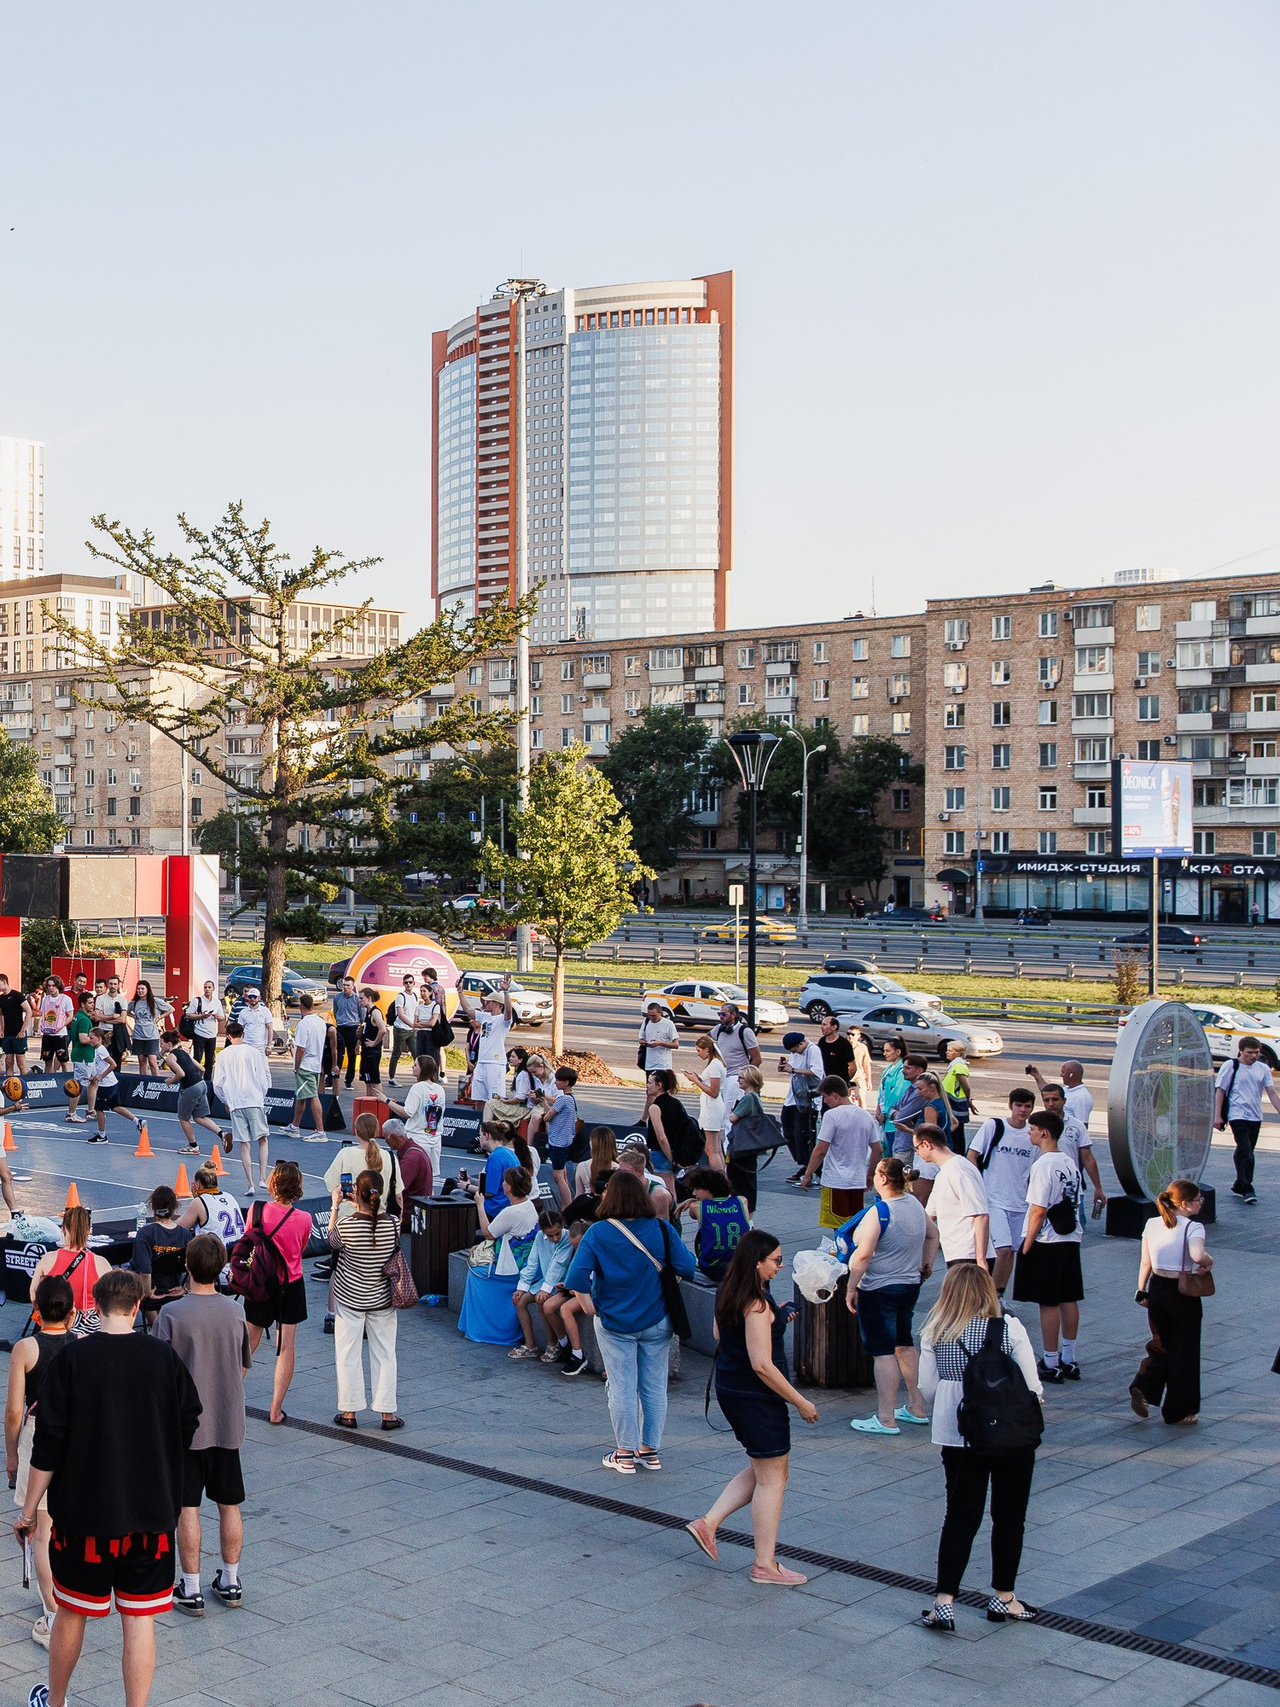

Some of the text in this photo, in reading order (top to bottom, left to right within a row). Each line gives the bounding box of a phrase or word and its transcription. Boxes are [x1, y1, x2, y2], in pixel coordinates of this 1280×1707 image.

[1017, 863, 1141, 873] ИМИДЖ-СТУДИЯ
[146, 1082, 180, 1093] МОСКОВСКИЙ
[144, 1091, 161, 1100] СПОРТ
[263, 1096, 295, 1108] ОСКОВСКИЙ
[442, 1127, 456, 1137] ОРТ
[218, 1207, 246, 1239] 24
[711, 1222, 741, 1250] 18
